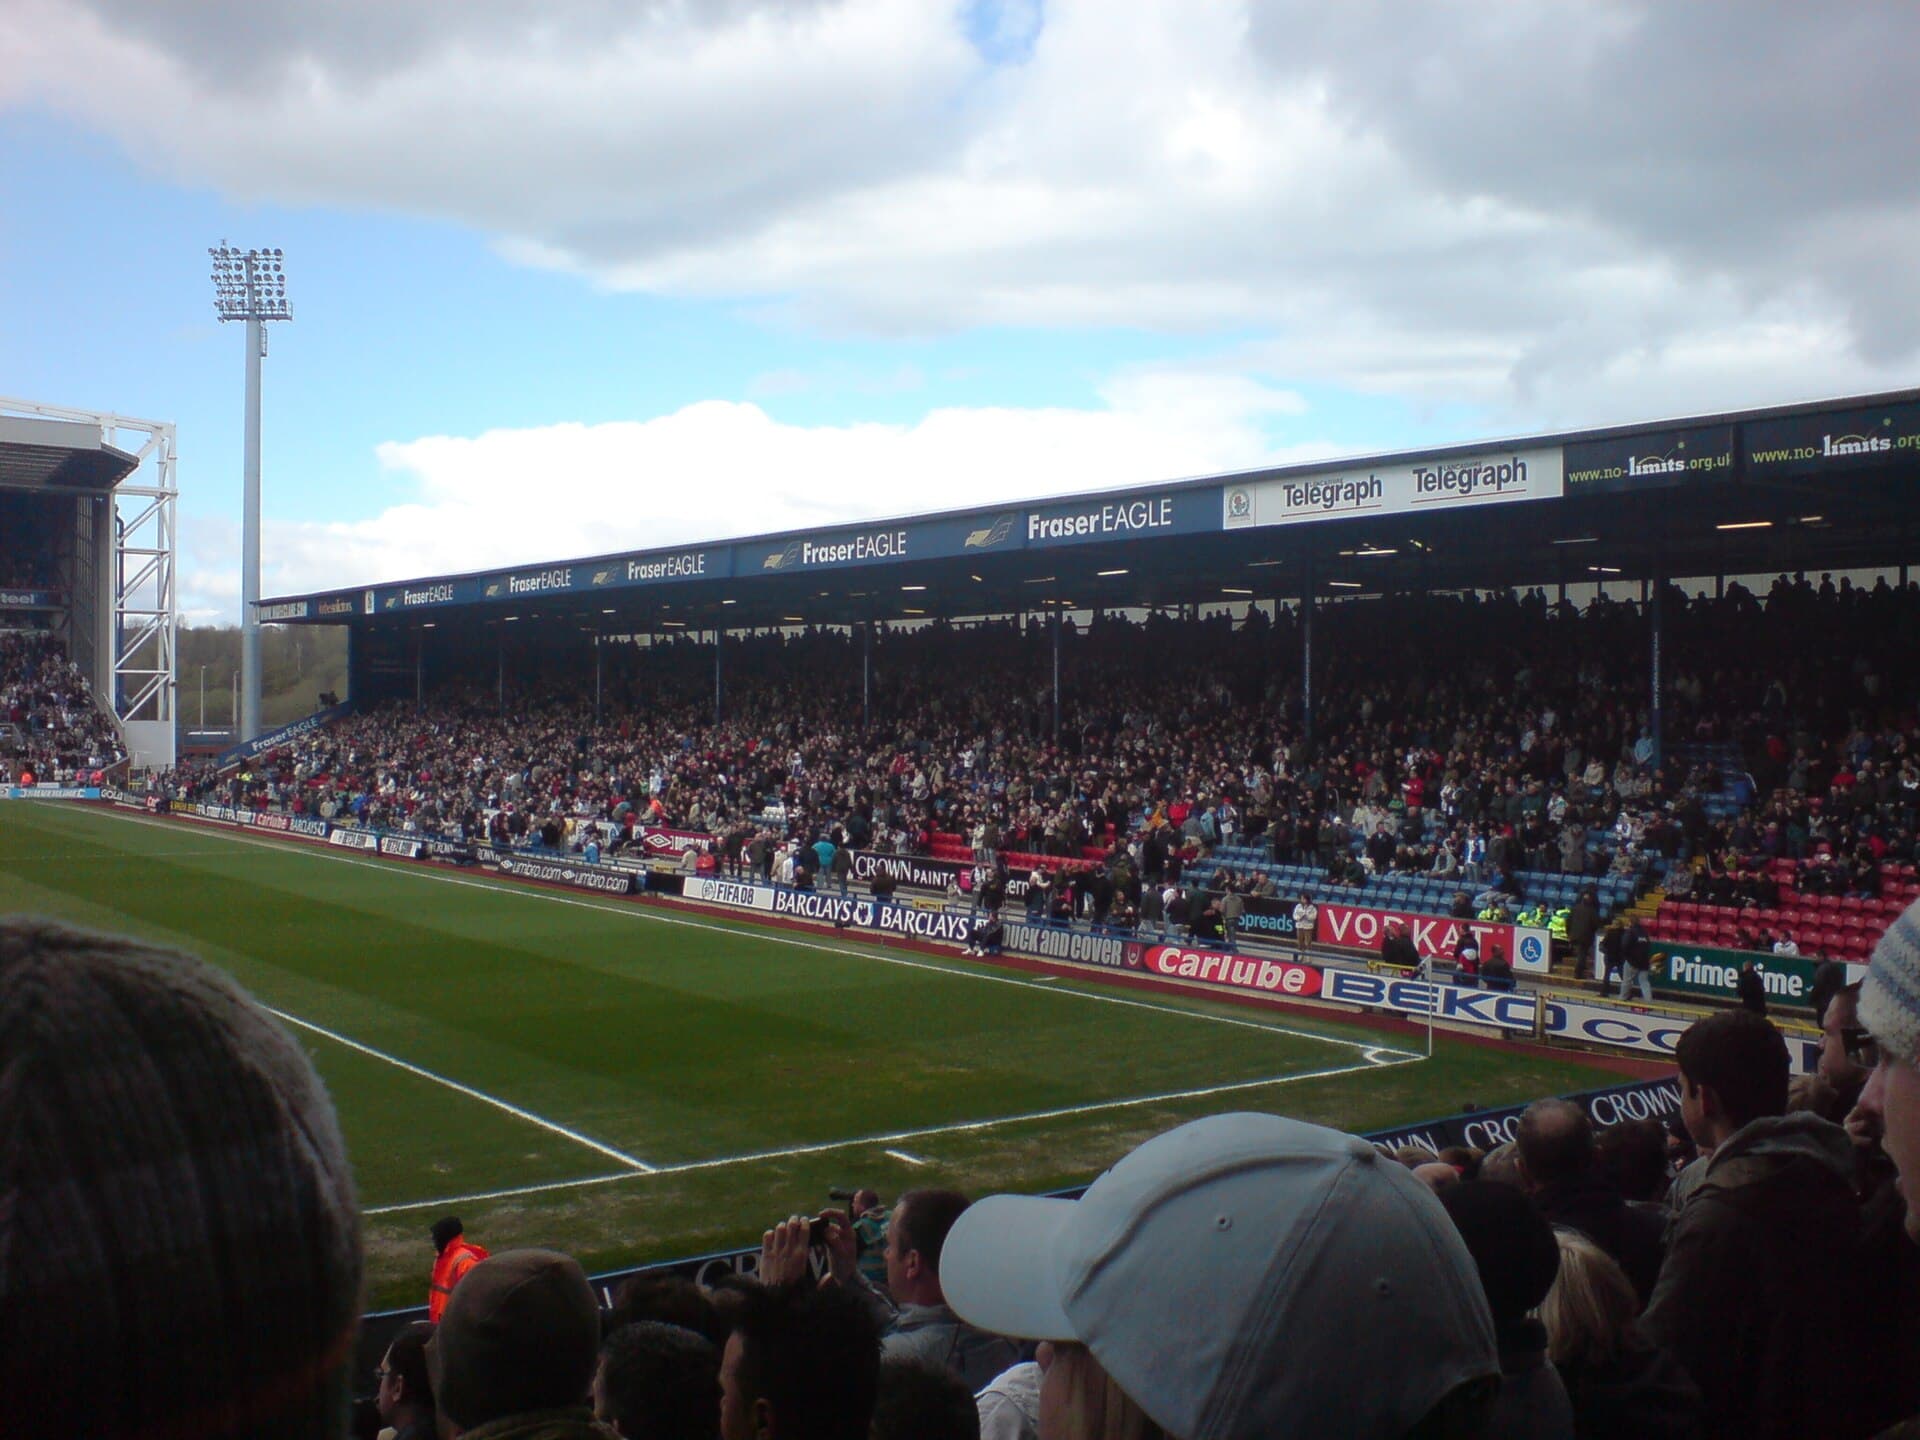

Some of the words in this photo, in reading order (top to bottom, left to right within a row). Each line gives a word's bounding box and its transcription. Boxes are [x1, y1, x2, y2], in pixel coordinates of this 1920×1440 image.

[1282, 475, 1382, 509] Telegraph
[1412, 457, 1527, 494] Telegraph
[512, 861, 561, 881] umbro.com
[574, 872, 629, 894] umbro.com
[776, 893, 850, 921] BARCLAYS
[880, 906, 968, 940] BARCLAYS
[1158, 947, 1306, 993] Carlube
[1331, 973, 1567, 1033] BEKO
[1591, 1084, 1682, 1126] CROWN
